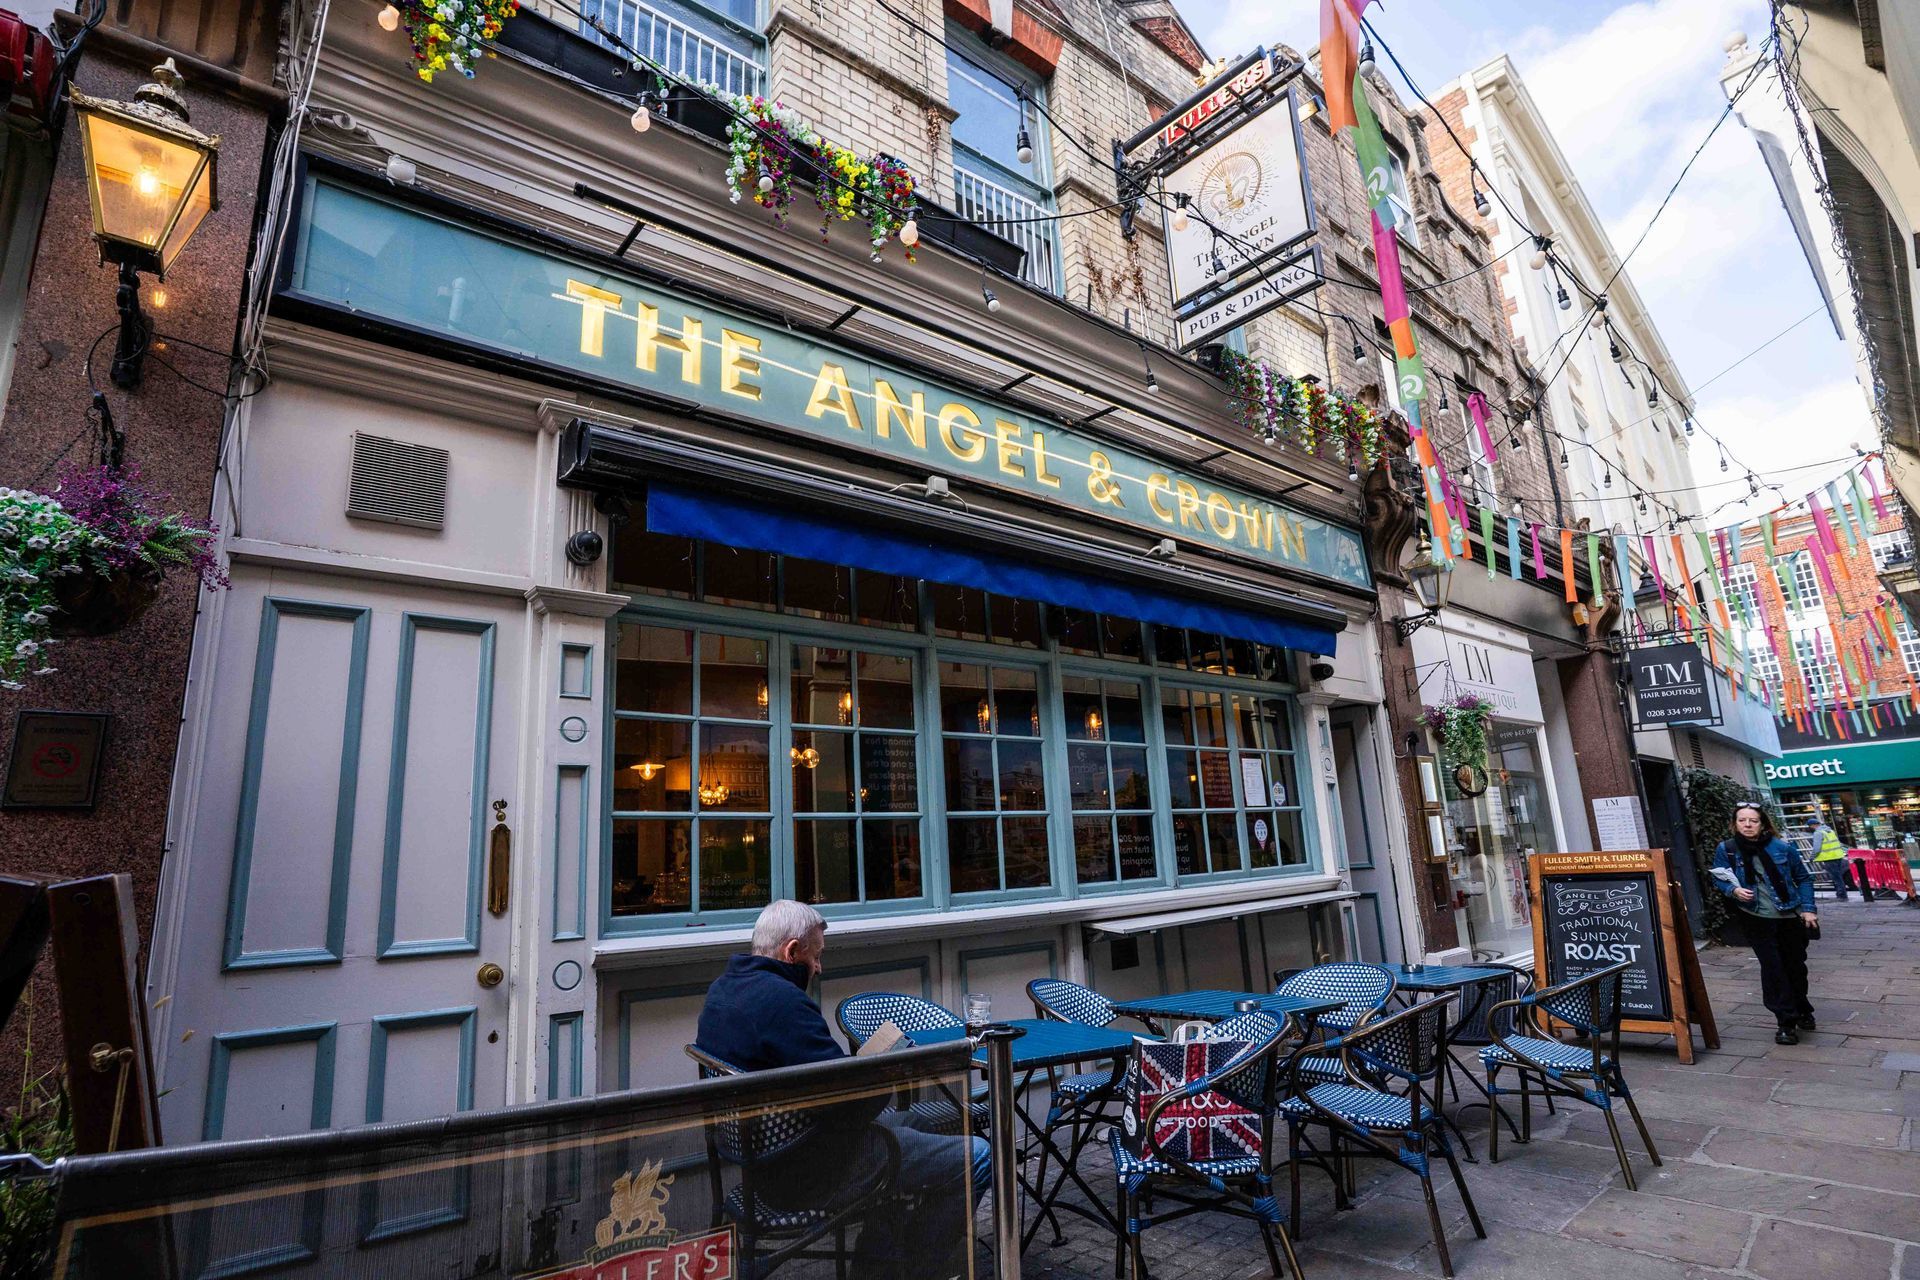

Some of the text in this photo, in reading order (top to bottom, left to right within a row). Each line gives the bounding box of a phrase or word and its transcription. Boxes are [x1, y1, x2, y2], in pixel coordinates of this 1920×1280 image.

[1193, 214, 1278, 267] THE ANGEL
[1222, 233, 1275, 268] CROWN
[1189, 266, 1307, 335] PUB & DINING
[564, 278, 1308, 564] THE ANGEL & CROWN
[1457, 641, 1496, 686] TM
[1641, 660, 1696, 687] TM
[1475, 689, 1518, 711] OUTIQUE
[1640, 686, 1704, 700] HAIR BOUTIQUE
[1646, 705, 1702, 718] 0208 334 9919
[1763, 758, 1845, 779] Barrett
[1544, 853, 1646, 865] FULLER SMITH & TURNER
[1579, 898, 1633, 911] & CROWN
[1558, 915, 1642, 933] TRADITIONAL
[1570, 931, 1628, 943] SUNDAY
[1564, 943, 1641, 962] ROAST
[1628, 1002, 1654, 1010] SUNDAY
[1178, 1116, 1219, 1129] FOOD
